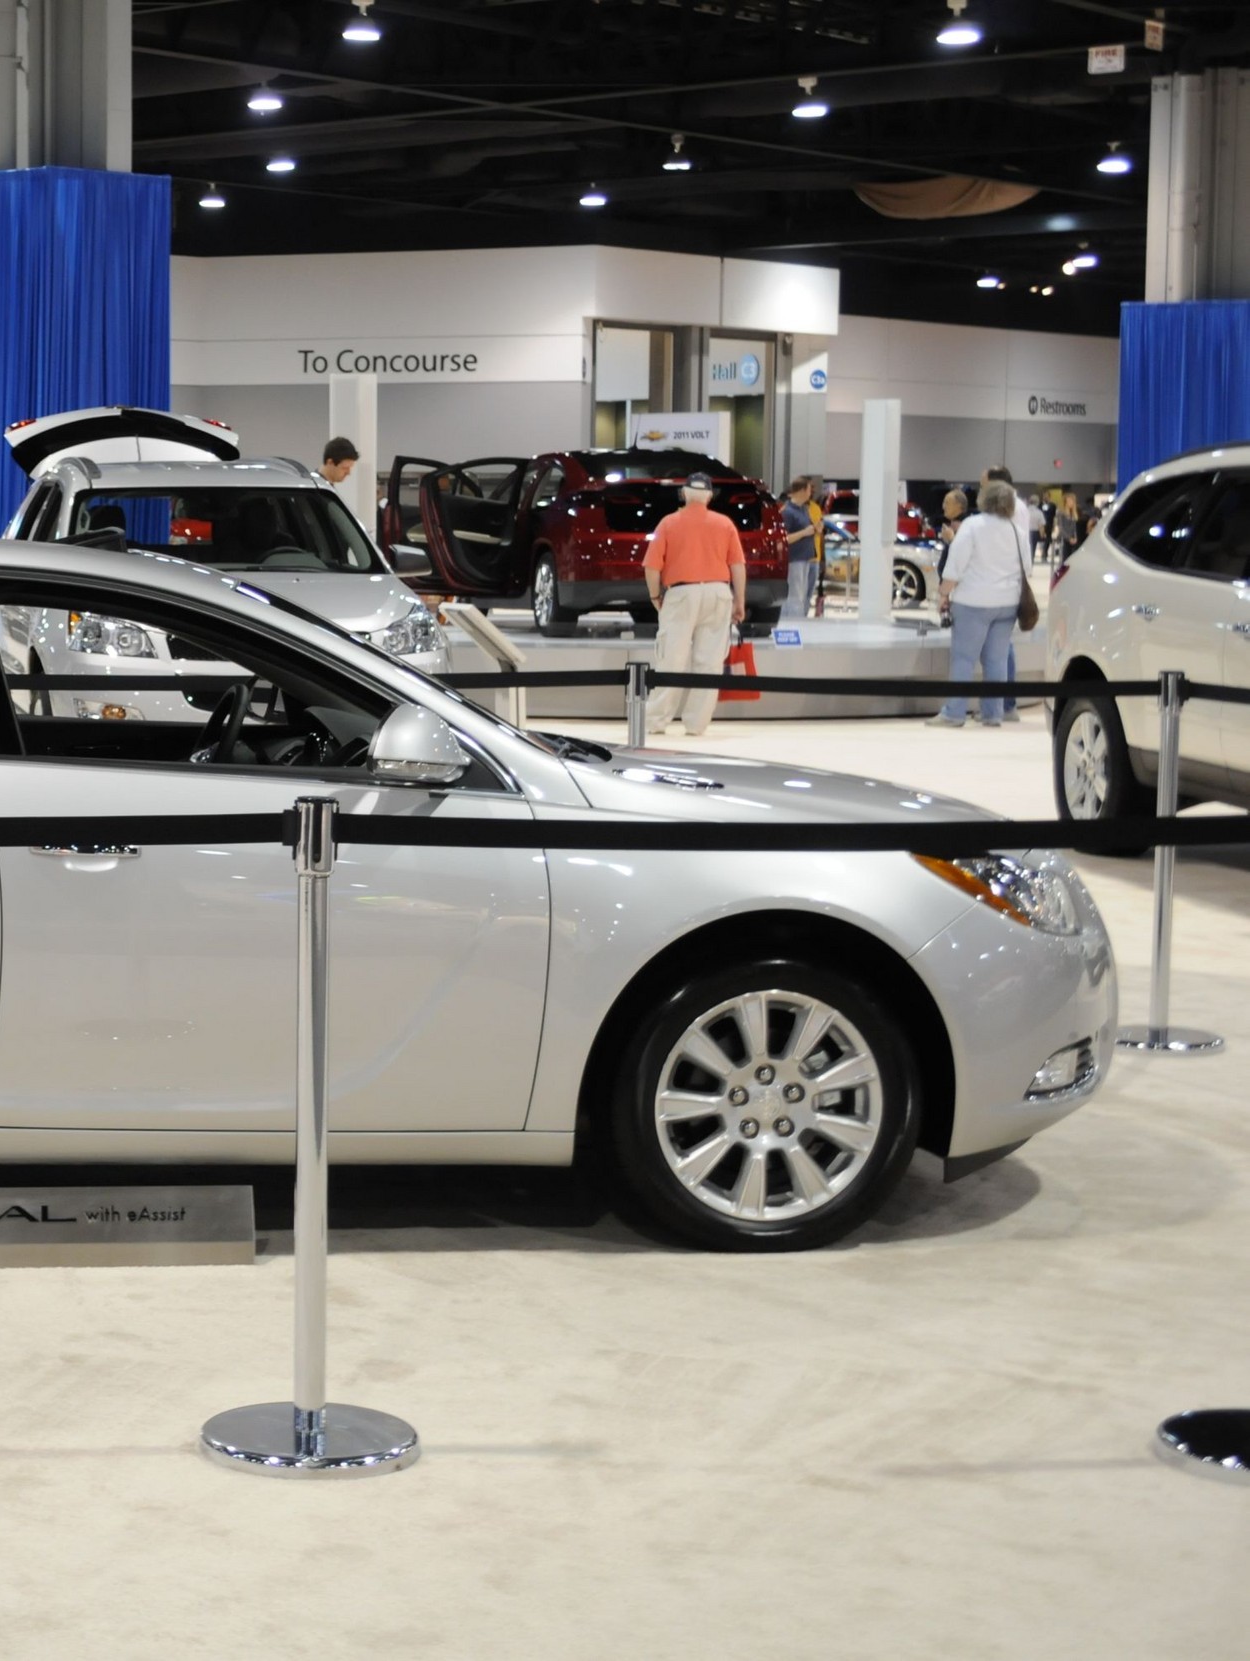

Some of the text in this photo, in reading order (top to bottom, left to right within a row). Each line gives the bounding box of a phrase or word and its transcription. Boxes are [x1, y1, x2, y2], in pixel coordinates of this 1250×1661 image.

[298, 349, 478, 373] To Concourse
[712, 362, 737, 380] Hall
[1040, 397, 1086, 417] Restrooms
[673, 430, 710, 440] 2011 VOLT
[85, 1205, 121, 1222] with
[127, 1206, 187, 1222] eAssist
